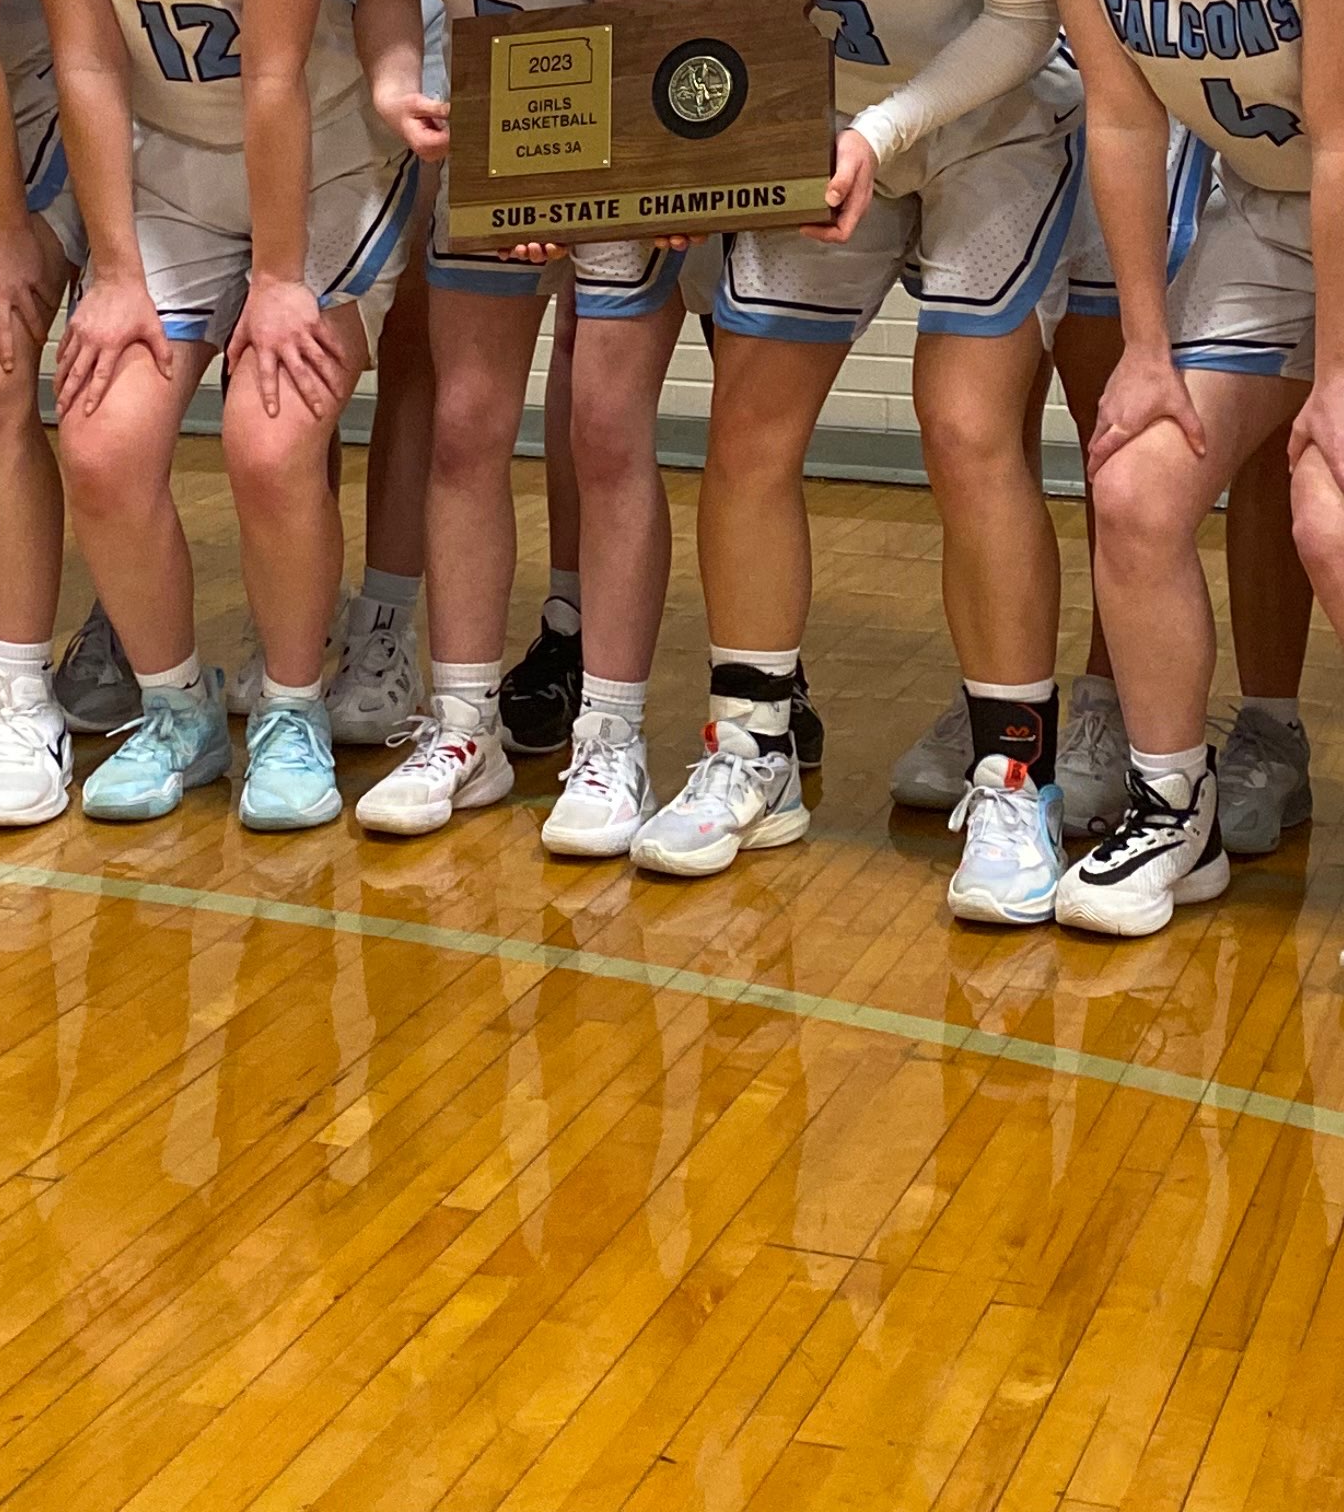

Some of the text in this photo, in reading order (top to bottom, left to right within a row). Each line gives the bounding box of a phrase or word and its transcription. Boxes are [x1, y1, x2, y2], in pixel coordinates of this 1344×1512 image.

[136, 0, 241, 82] 12
[529, 54, 573, 73] 2023
[528, 97, 572, 113] GIRLS
[501, 112, 598, 133] BASKETBALL
[516, 140, 582, 157] CLASS 3A
[491, 185, 786, 228] SUB-STATE CHAMPIONS
